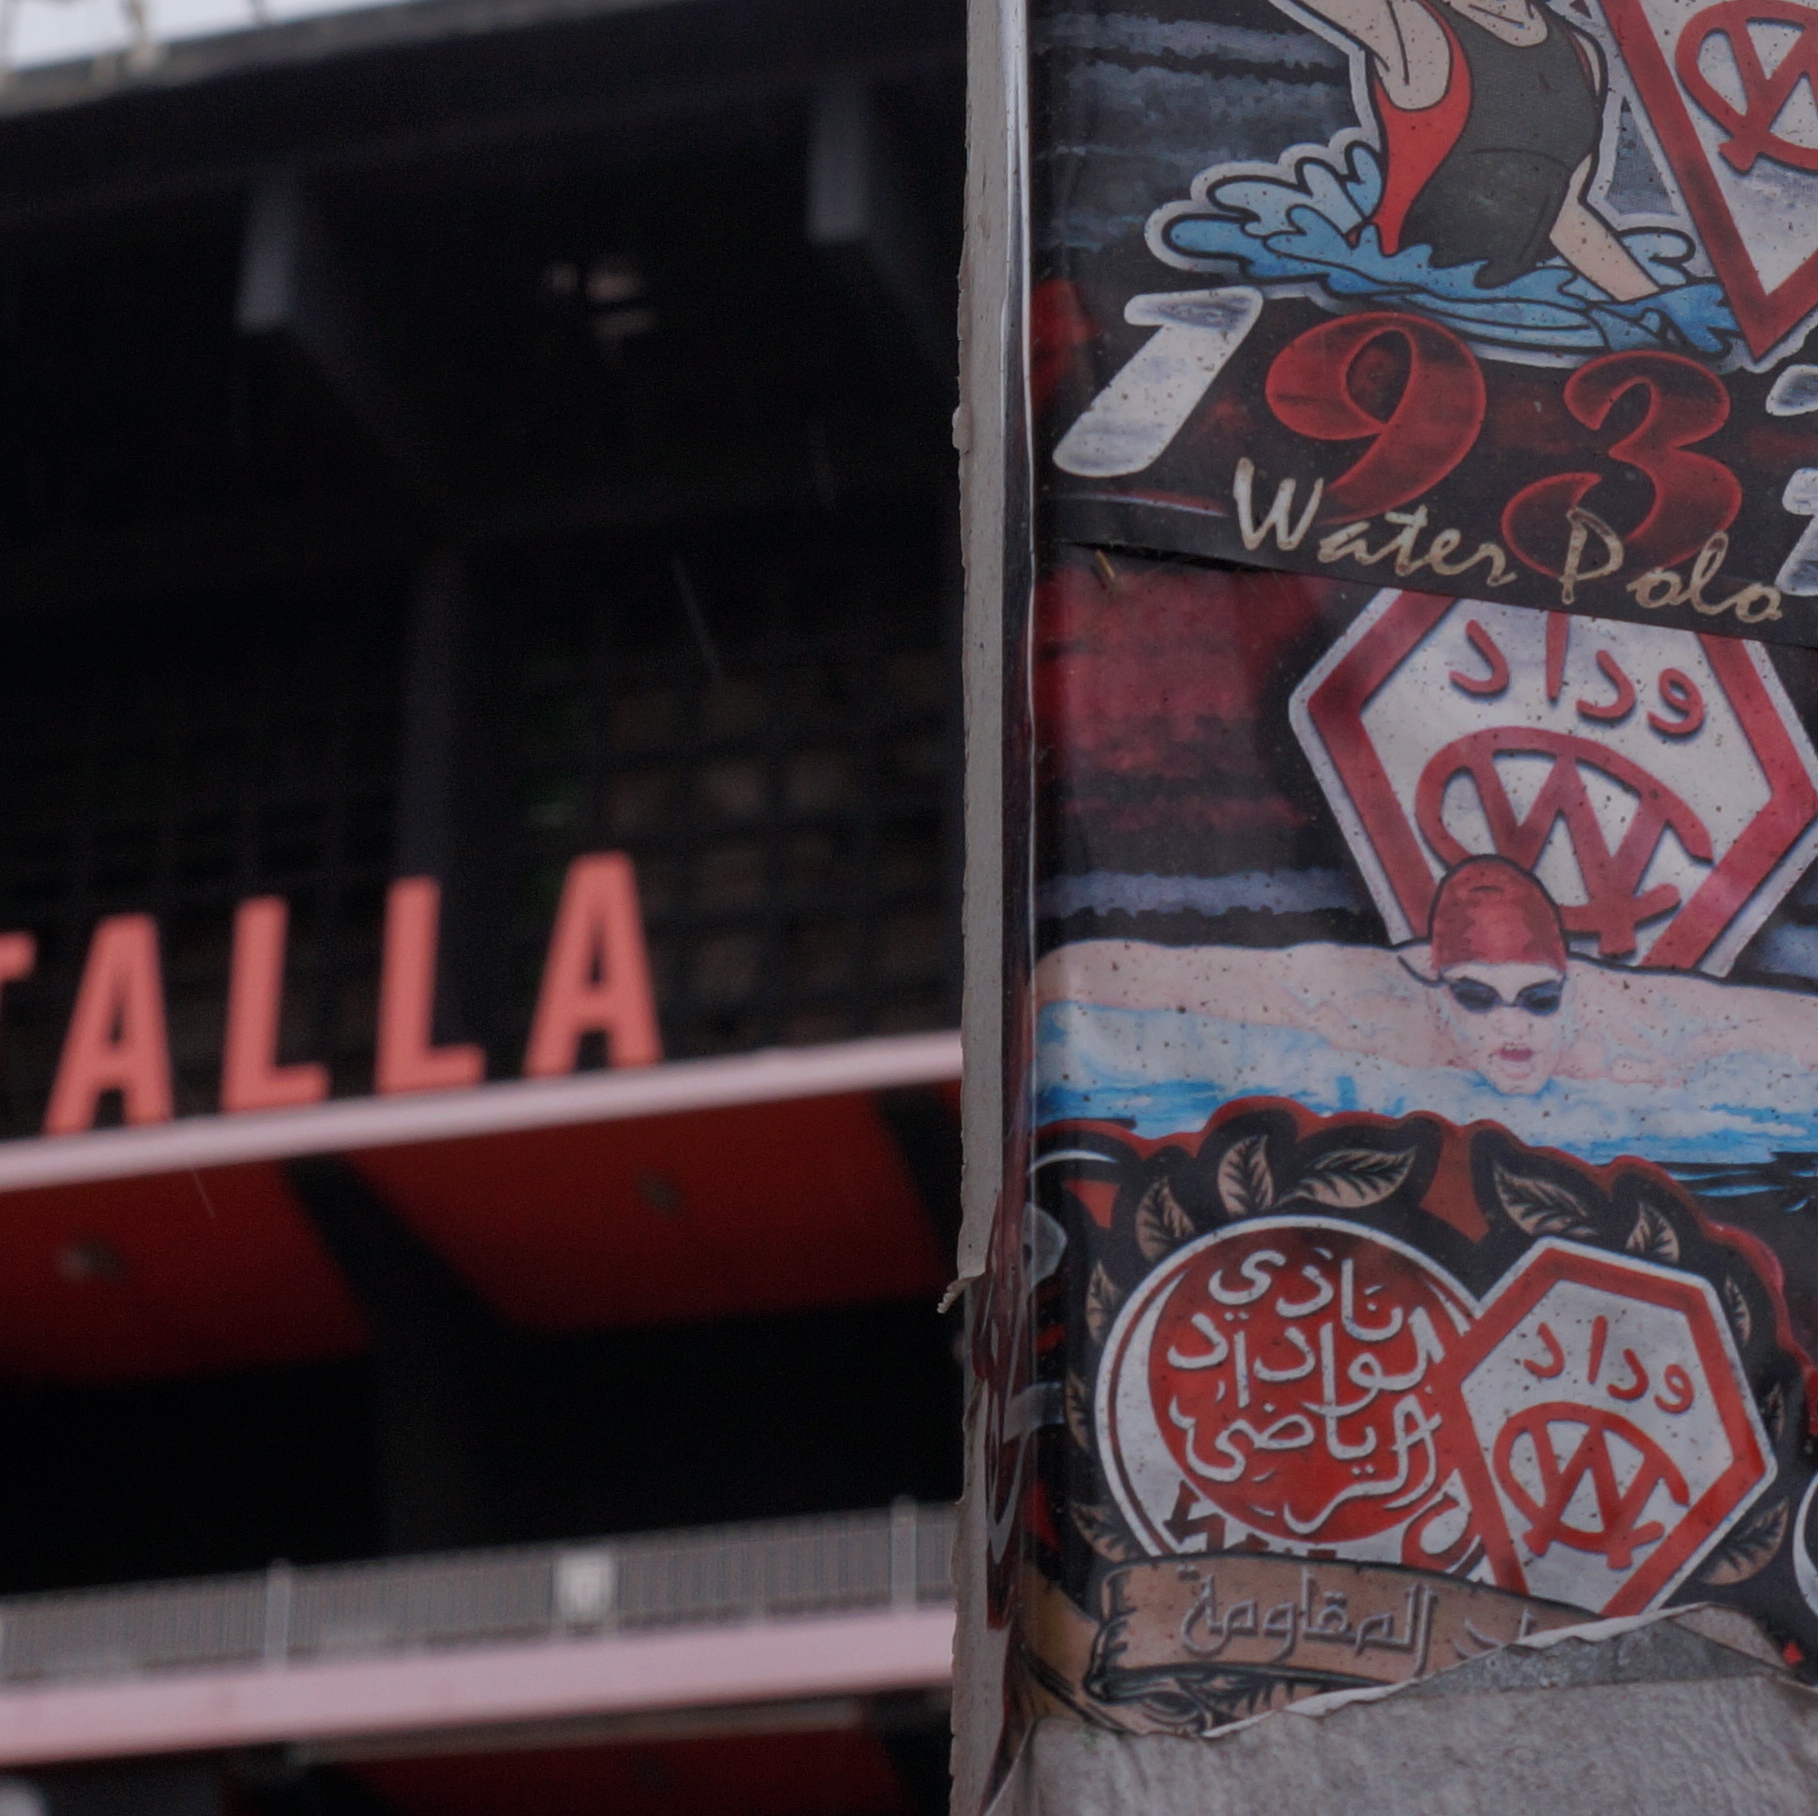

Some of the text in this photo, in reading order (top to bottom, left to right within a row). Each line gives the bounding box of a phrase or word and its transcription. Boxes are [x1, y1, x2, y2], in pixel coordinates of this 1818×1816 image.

[1231, 458, 1785, 625] Water Polo
[1521, 1322, 1693, 1412] وداد
[1178, 1564, 1438, 1677] المقاومة
